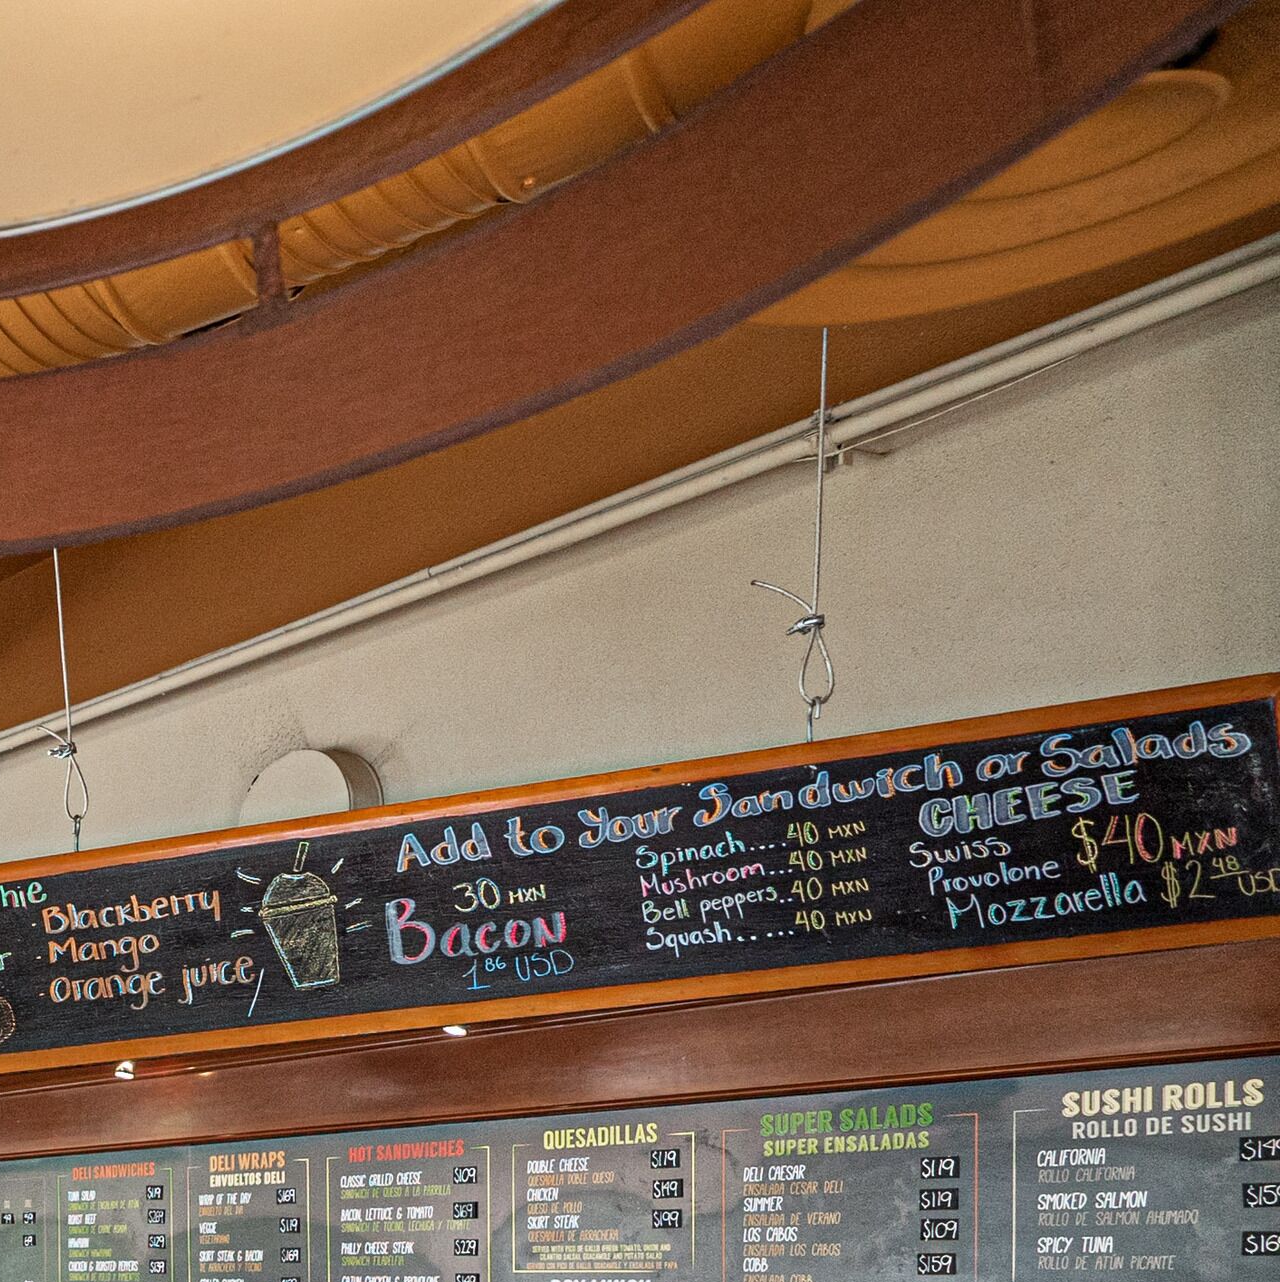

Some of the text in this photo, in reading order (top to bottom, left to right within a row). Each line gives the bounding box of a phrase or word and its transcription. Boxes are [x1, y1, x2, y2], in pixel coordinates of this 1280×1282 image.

[397, 822, 491, 872] Add
[504, 816, 565, 856] to
[577, 806, 682, 848] Your
[977, 752, 1030, 781] or
[1041, 720, 1252, 778] Salads
[918, 770, 1140, 838] CHEESE
[786, 821, 819, 847] 40
[828, 820, 866, 839] MXN
[1171, 826, 1237, 859] MXN
[789, 850, 823, 871] 40
[831, 847, 867, 867] MXN
[928, 860, 1061, 895] Provolone
[453, 877, 546, 912] 30 MXN
[641, 899, 689, 924] Bell
[791, 876, 822, 903] 40
[831, 877, 870, 896] MXN
[945, 871, 1147, 930] Mozzarella
[42, 890, 220, 934] Blackberry
[795, 910, 825, 932] 40
[835, 909, 872, 927] MXN
[48, 934, 160, 973] Mango
[515, 950, 574, 981] USD
[49, 956, 255, 1011] Orange juice
[1061, 1078, 1264, 1118] SUSHI ROLLS
[760, 1102, 934, 1137] SUPER SALADS
[1072, 1111, 1251, 1139] ROLLO DE SUSHI
[543, 1122, 658, 1150] QUESADILLAS
[763, 1131, 930, 1157] SUPER ENSALADAS
[348, 1139, 465, 1163] HOT SANDWICHES
[651, 1150, 676, 1168] $119
[1037, 1147, 1106, 1167] CALIFORNIA
[72, 1162, 155, 1181] DELI SANDWICHES
[209, 1151, 285, 1172] DELI WRAPS
[527, 1157, 589, 1174] DOUBLE CHEESE
[921, 1158, 955, 1178] $119
[209, 1171, 285, 1188] ENVUELTOS DELI
[396, 1171, 422, 1185] CHEESE
[453, 1167, 476, 1183] $109
[743, 1164, 806, 1182] DELI CAESAR
[1037, 1166, 1135, 1183] ROLLO CALIFORNIA
[527, 1188, 559, 1202] CHICKEN
[653, 1181, 677, 1198] $149
[743, 1182, 785, 1196] ENSALADA
[824, 1180, 844, 1193] DELI
[743, 1197, 783, 1212] SUMMER
[920, 1191, 952, 1209] $119
[1037, 1190, 1147, 1210] SMOKED SALMON
[527, 1215, 579, 1229] SKIRT STEAK
[653, 1211, 679, 1228] $199
[743, 1212, 841, 1227] ENSALADA DE VERANO
[1037, 1208, 1199, 1227] ROLLO DE SALMÓN AHUMADO
[743, 1226, 798, 1242] LOS CABOS
[923, 1219, 958, 1242] $109
[364, 1241, 389, 1253] CHEESE
[393, 1241, 414, 1254] STEAK
[455, 1240, 476, 1255] $229
[743, 1243, 841, 1257] ENSALADA LOS CABOS
[1037, 1236, 1113, 1253] SPICY TUNA
[1244, 1234, 1280, 1254] $16
[743, 1257, 768, 1272] COBB
[918, 1255, 952, 1274] $159
[1037, 1253, 1176, 1271] ROLLO DE ATÚN PICANTE
